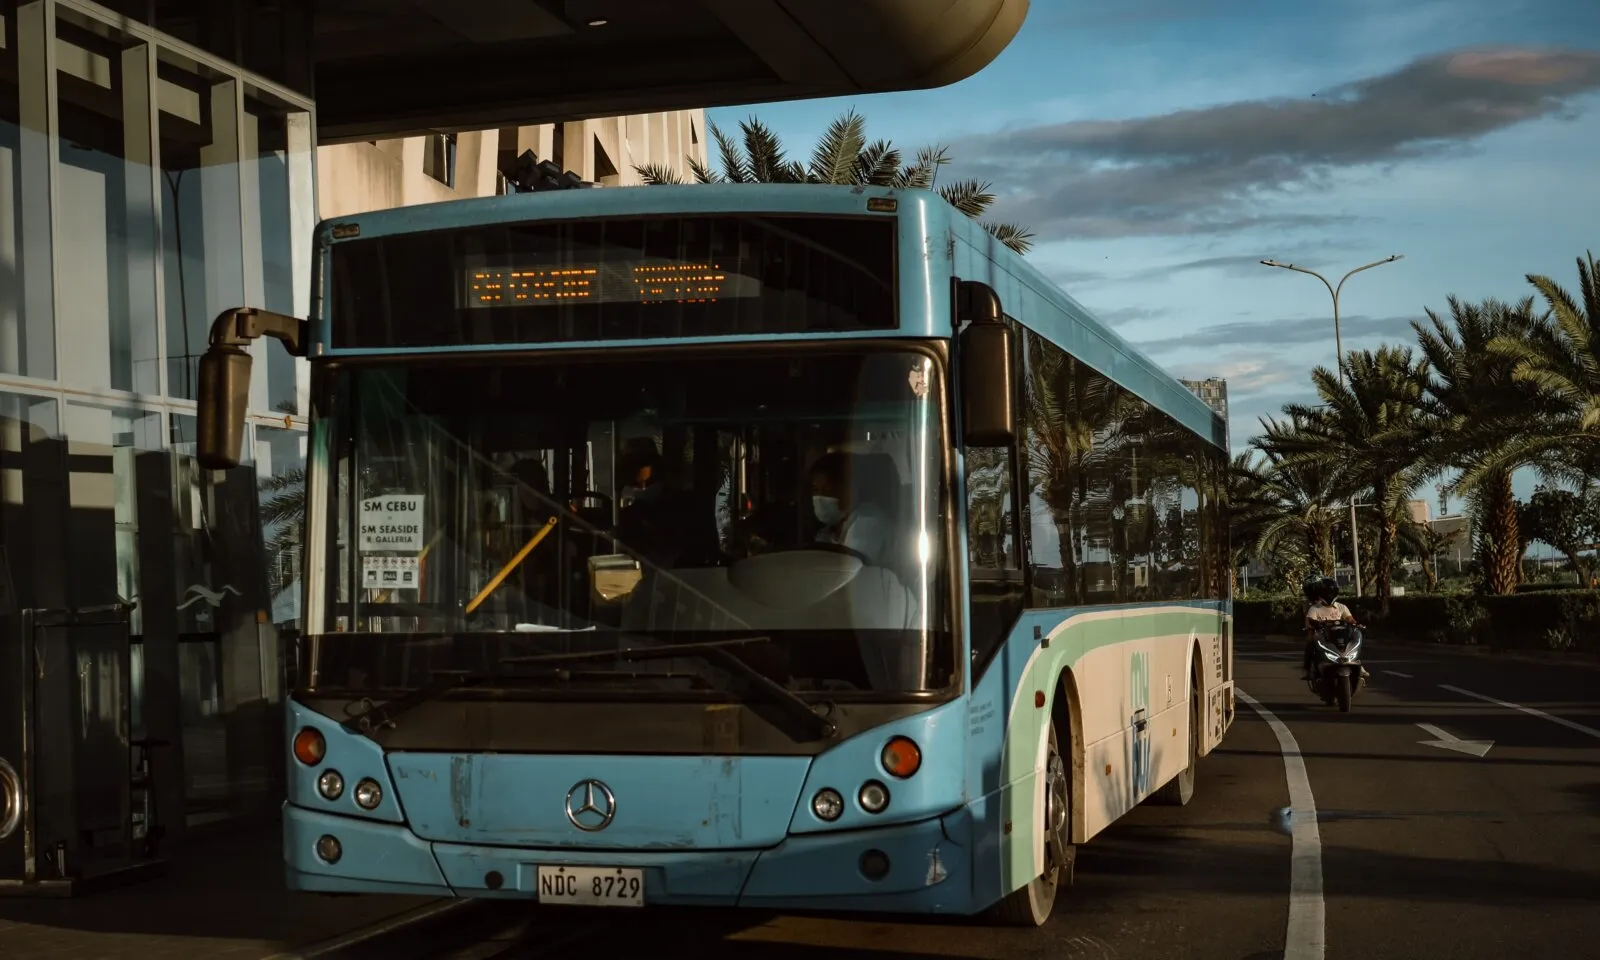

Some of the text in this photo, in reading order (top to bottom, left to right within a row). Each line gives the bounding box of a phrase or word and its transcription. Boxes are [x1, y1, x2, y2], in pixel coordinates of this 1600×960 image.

[364, 501, 417, 512] SM CEBU
[361, 525, 419, 534] SM SEASIDE
[542, 875, 640, 899] NDC 8729
